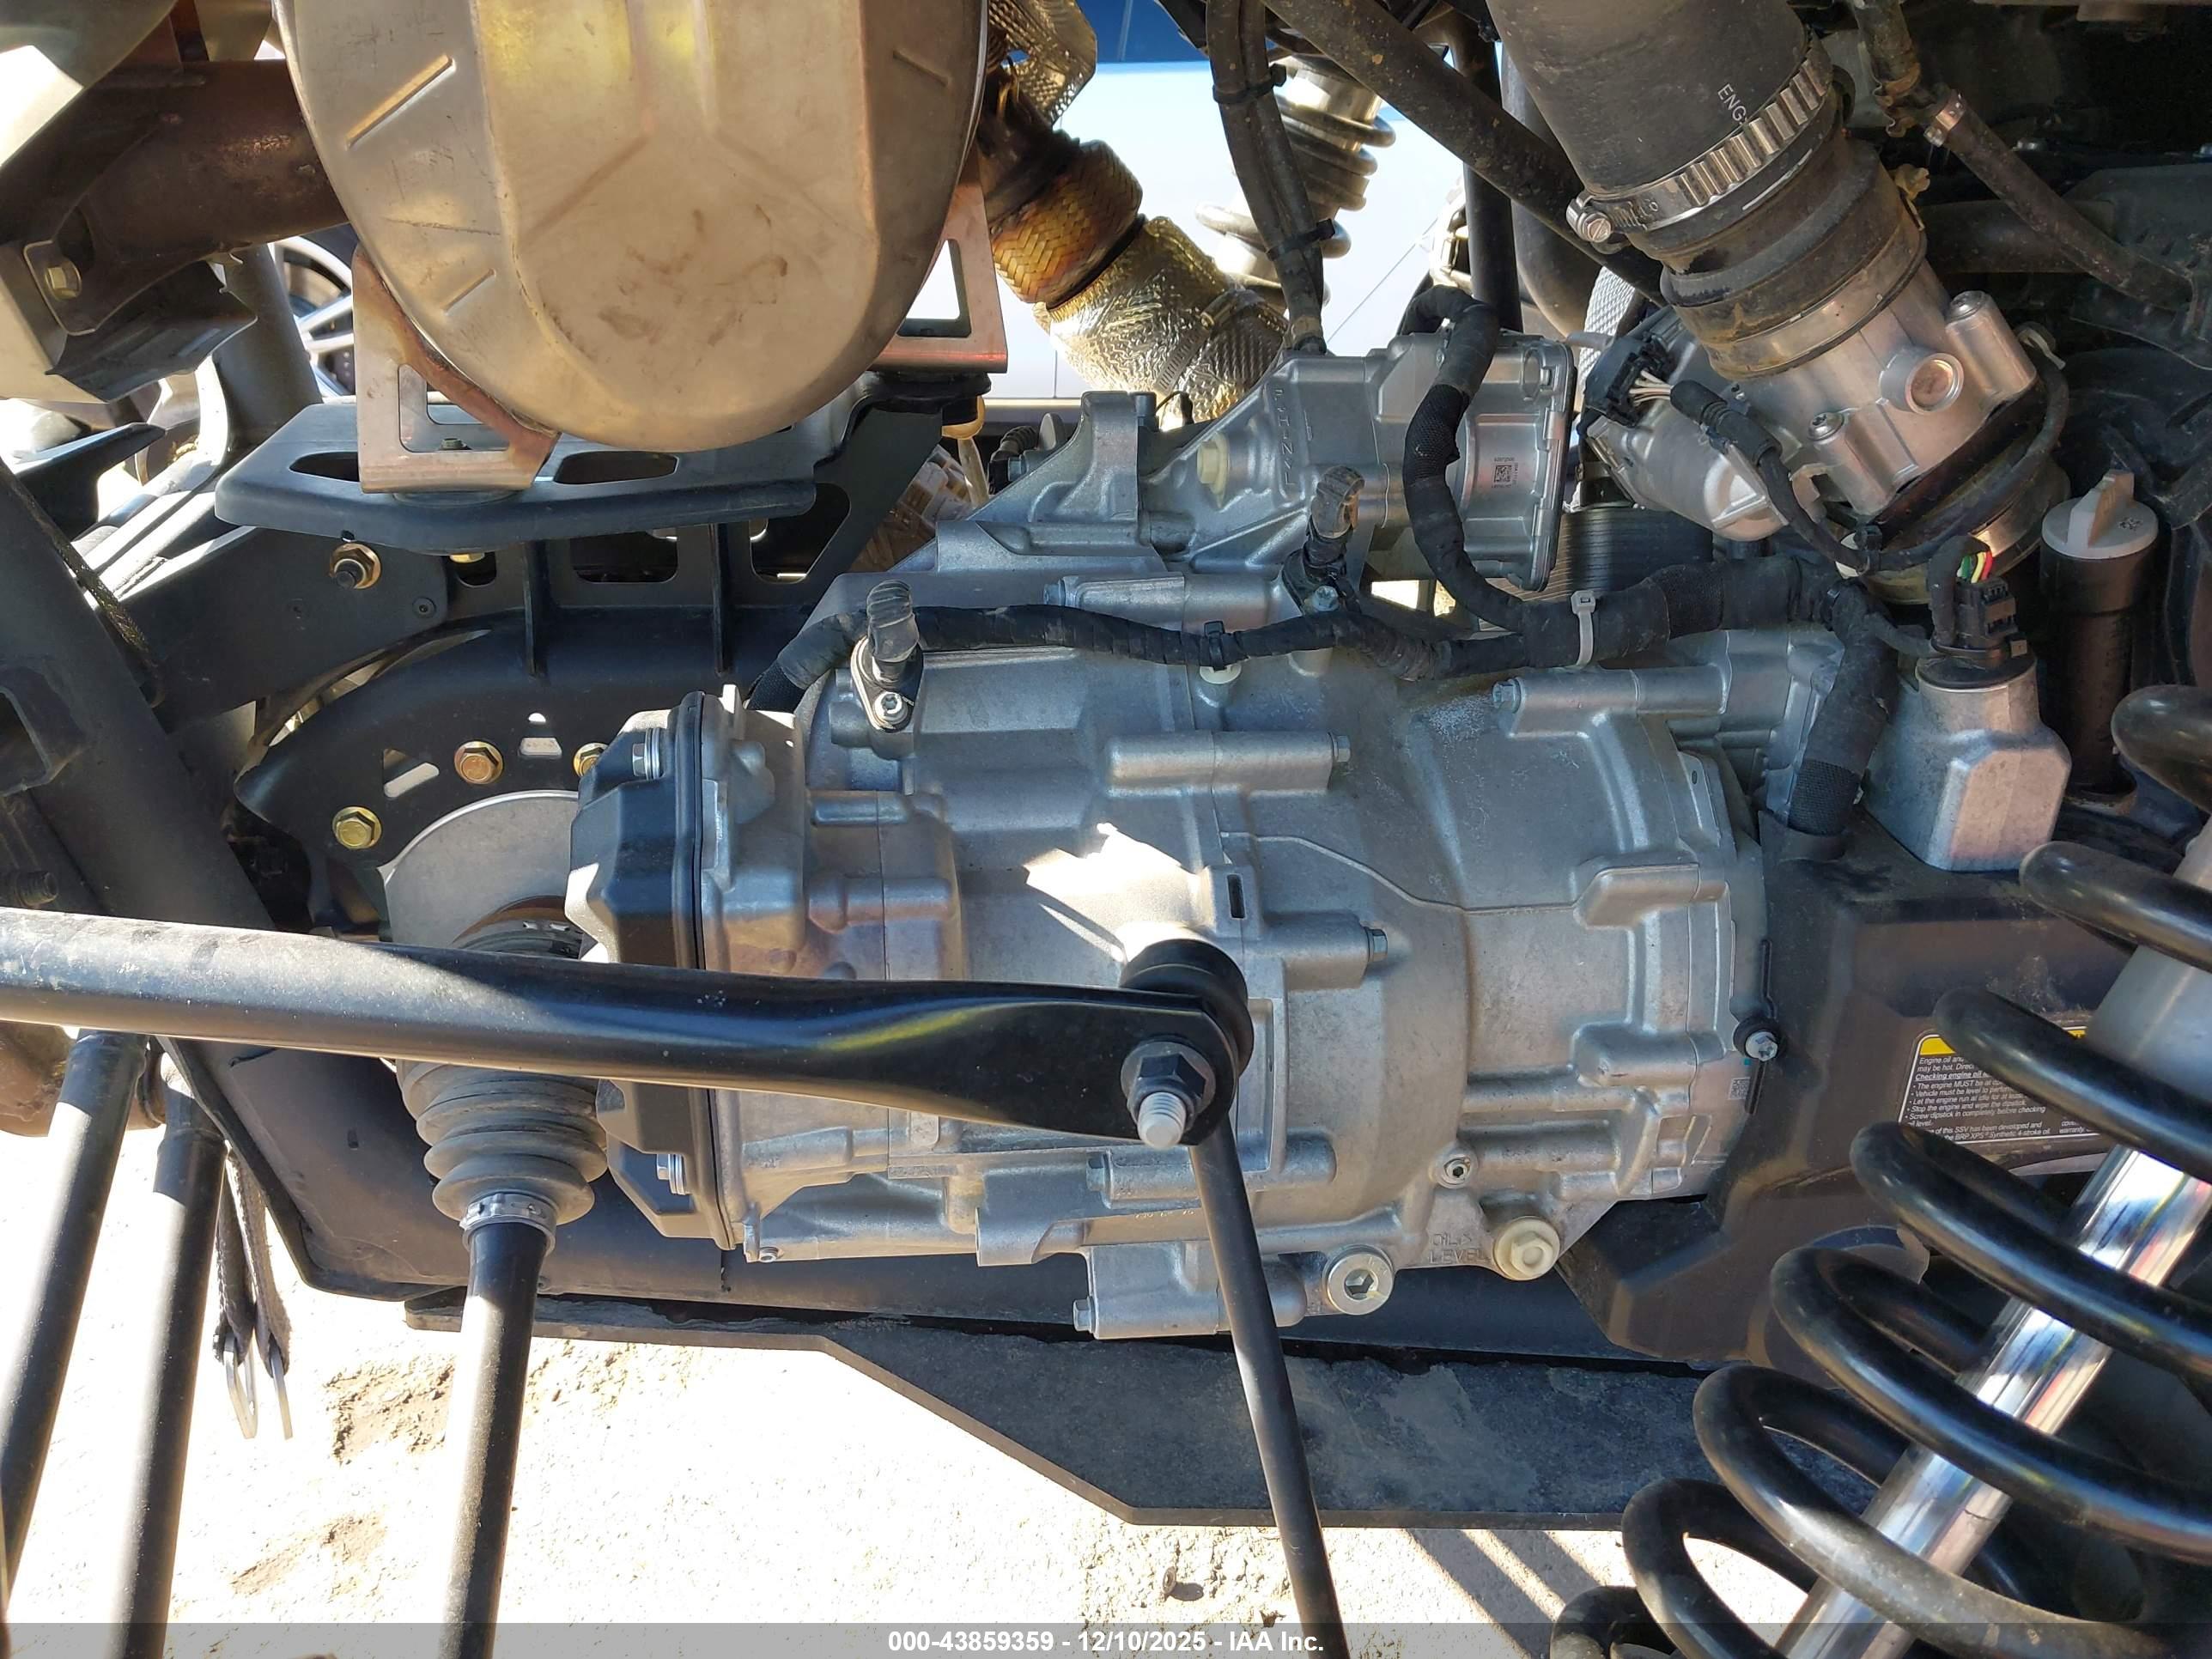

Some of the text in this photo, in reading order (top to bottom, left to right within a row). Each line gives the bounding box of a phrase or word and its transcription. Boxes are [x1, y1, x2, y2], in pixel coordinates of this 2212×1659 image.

[1717, 83, 1747, 125] ENG
[1930, 1111, 1954, 1120] dipstick
[1998, 1121, 2030, 1130] developed
[1429, 1248, 1492, 1264] LEVEL
